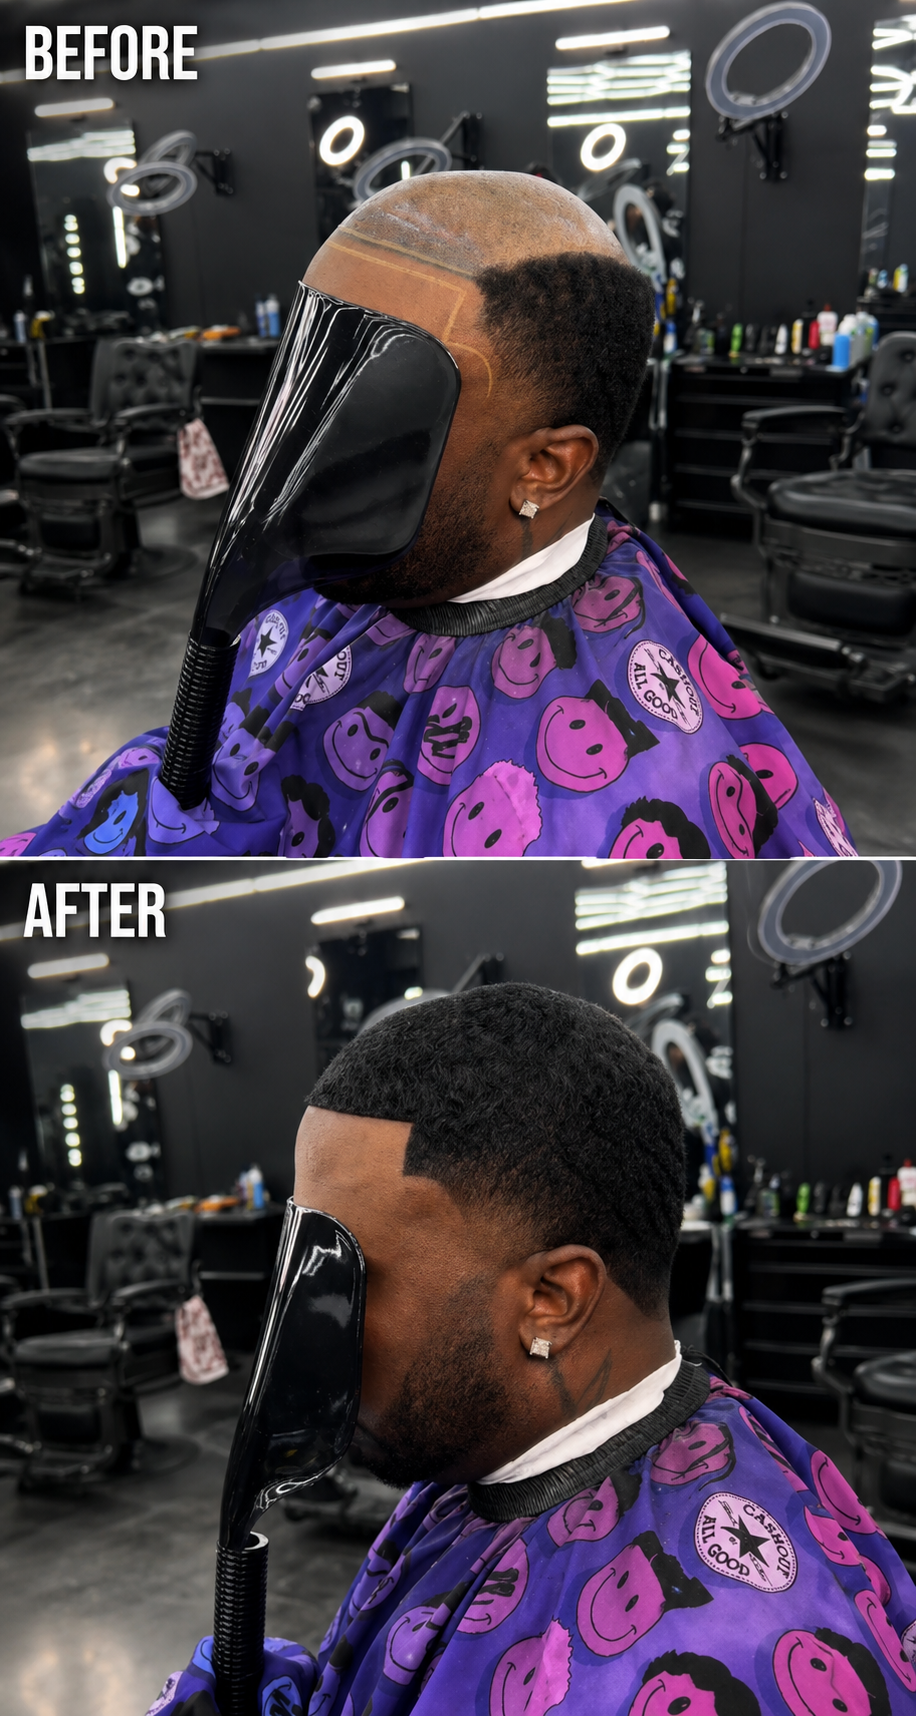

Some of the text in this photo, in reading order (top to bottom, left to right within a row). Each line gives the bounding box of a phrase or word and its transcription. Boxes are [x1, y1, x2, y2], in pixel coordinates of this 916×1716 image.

[633, 662, 648, 690] ALL
[643, 689, 678, 720] GOOD
[658, 649, 700, 717] CASHOUT
[701, 1514, 717, 1544] ALL
[742, 1503, 791, 1580] CASHOUT
[707, 1543, 750, 1577] GOOD
